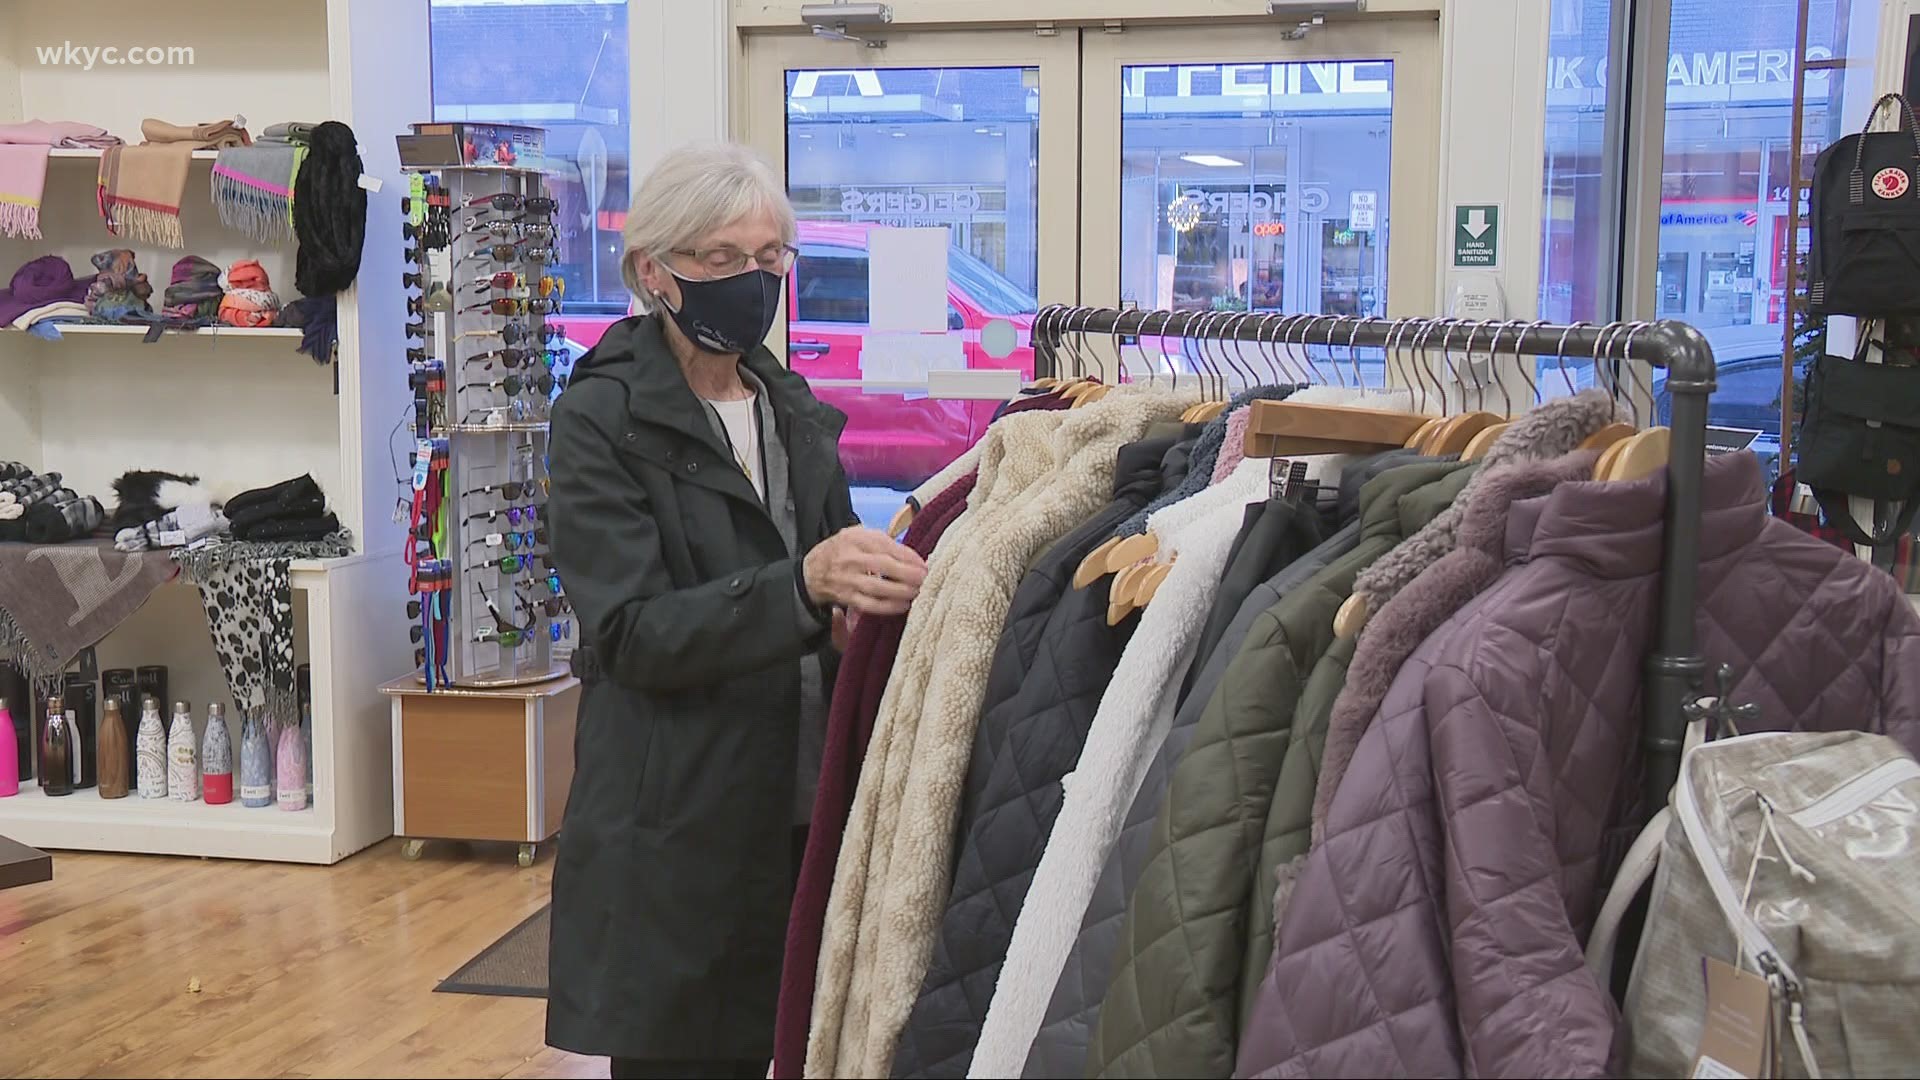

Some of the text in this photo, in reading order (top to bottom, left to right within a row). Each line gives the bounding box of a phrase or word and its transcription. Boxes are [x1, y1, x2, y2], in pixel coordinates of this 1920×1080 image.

[1358, 195, 1369, 203] NO
[1773, 186, 1810, 200] 140
[1675, 214, 1728, 225] America
[1254, 223, 1285, 238] open
